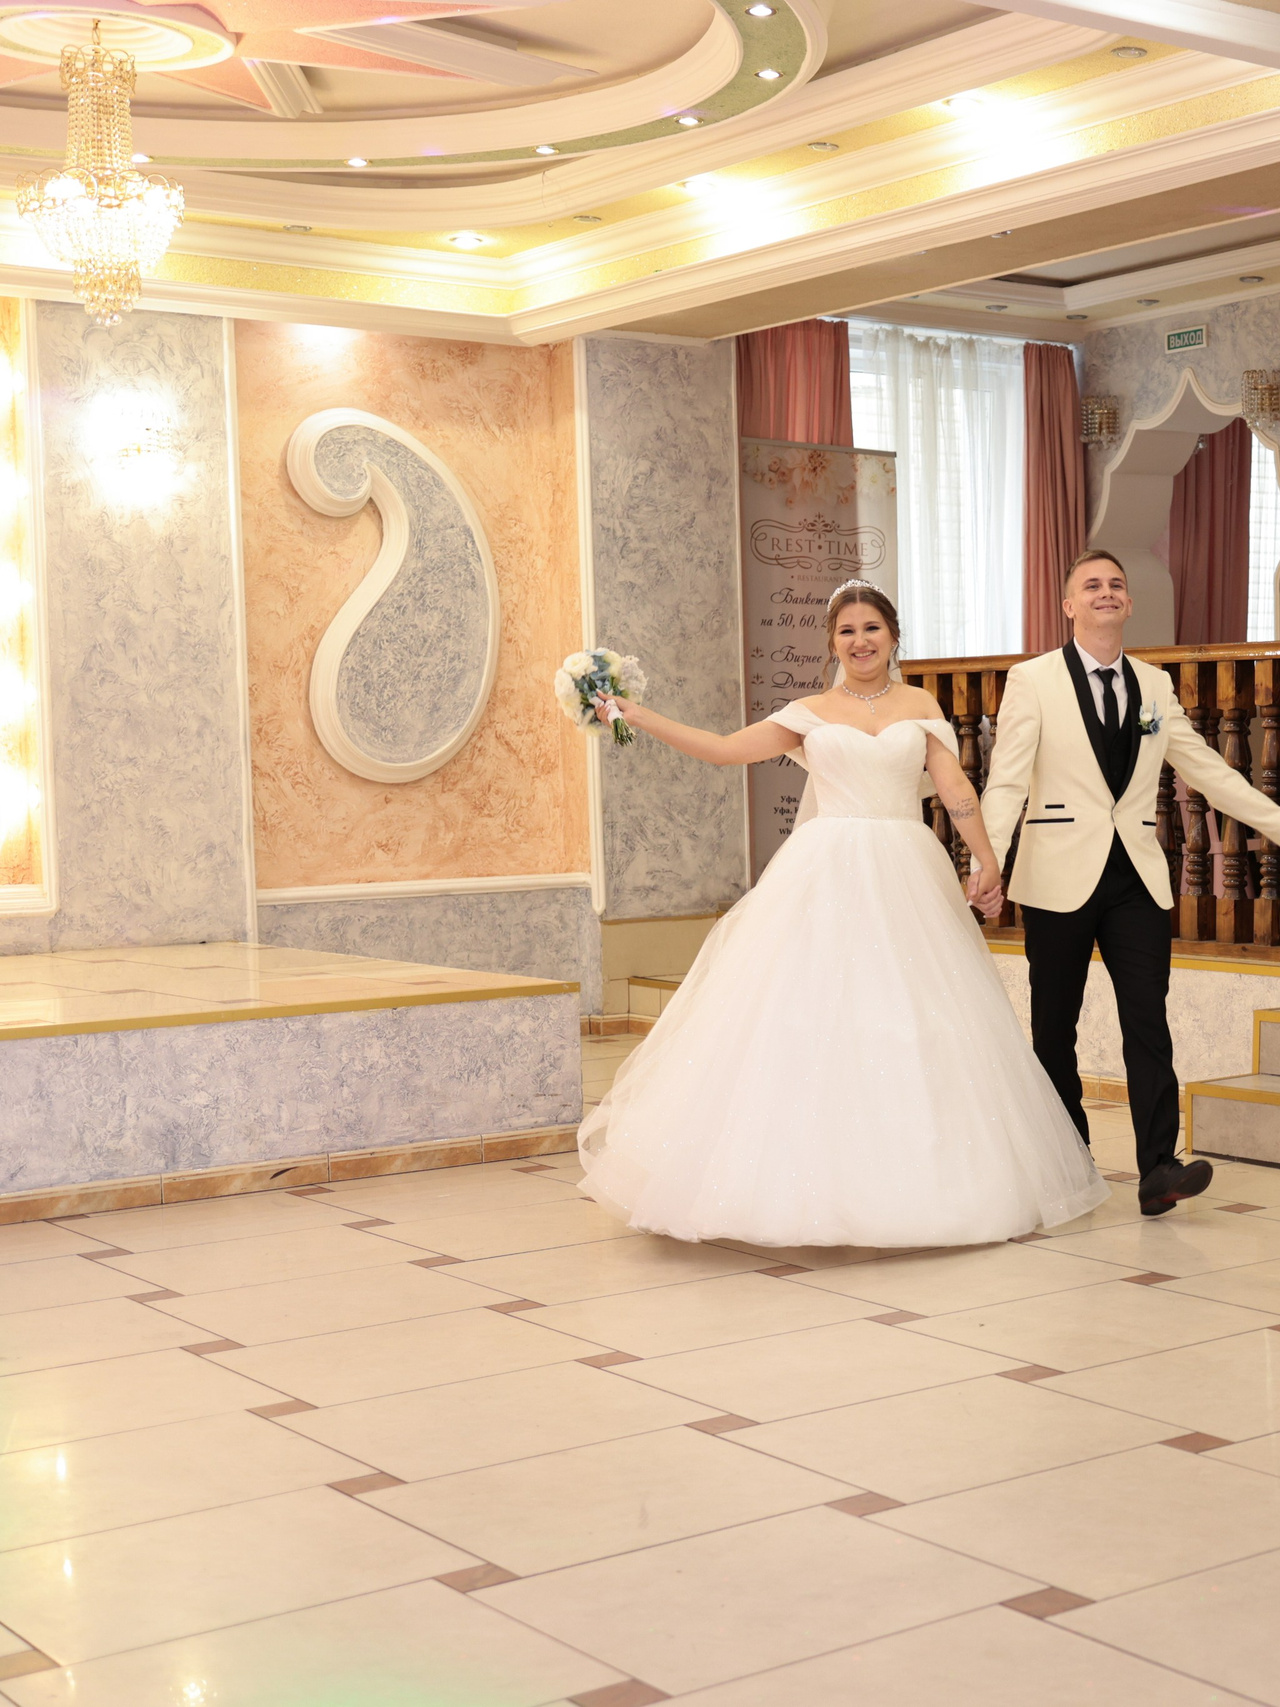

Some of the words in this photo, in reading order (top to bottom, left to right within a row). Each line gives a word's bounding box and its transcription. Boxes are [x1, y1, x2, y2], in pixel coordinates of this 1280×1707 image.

[1169, 331, 1203, 348] ВЫХОД
[771, 537, 815, 553] REST
[824, 540, 868, 556] TIME
[797, 574, 843, 583] RESTAURANT
[770, 587, 829, 606] Банкетн
[760, 617, 773, 627] на
[777, 613, 796, 630] 50,
[799, 614, 818, 631] 60,
[770, 645, 822, 667] Бизнес
[771, 671, 825, 689] Детски
[780, 795, 800, 804] Уфа,
[773, 806, 793, 816] Уфа,
